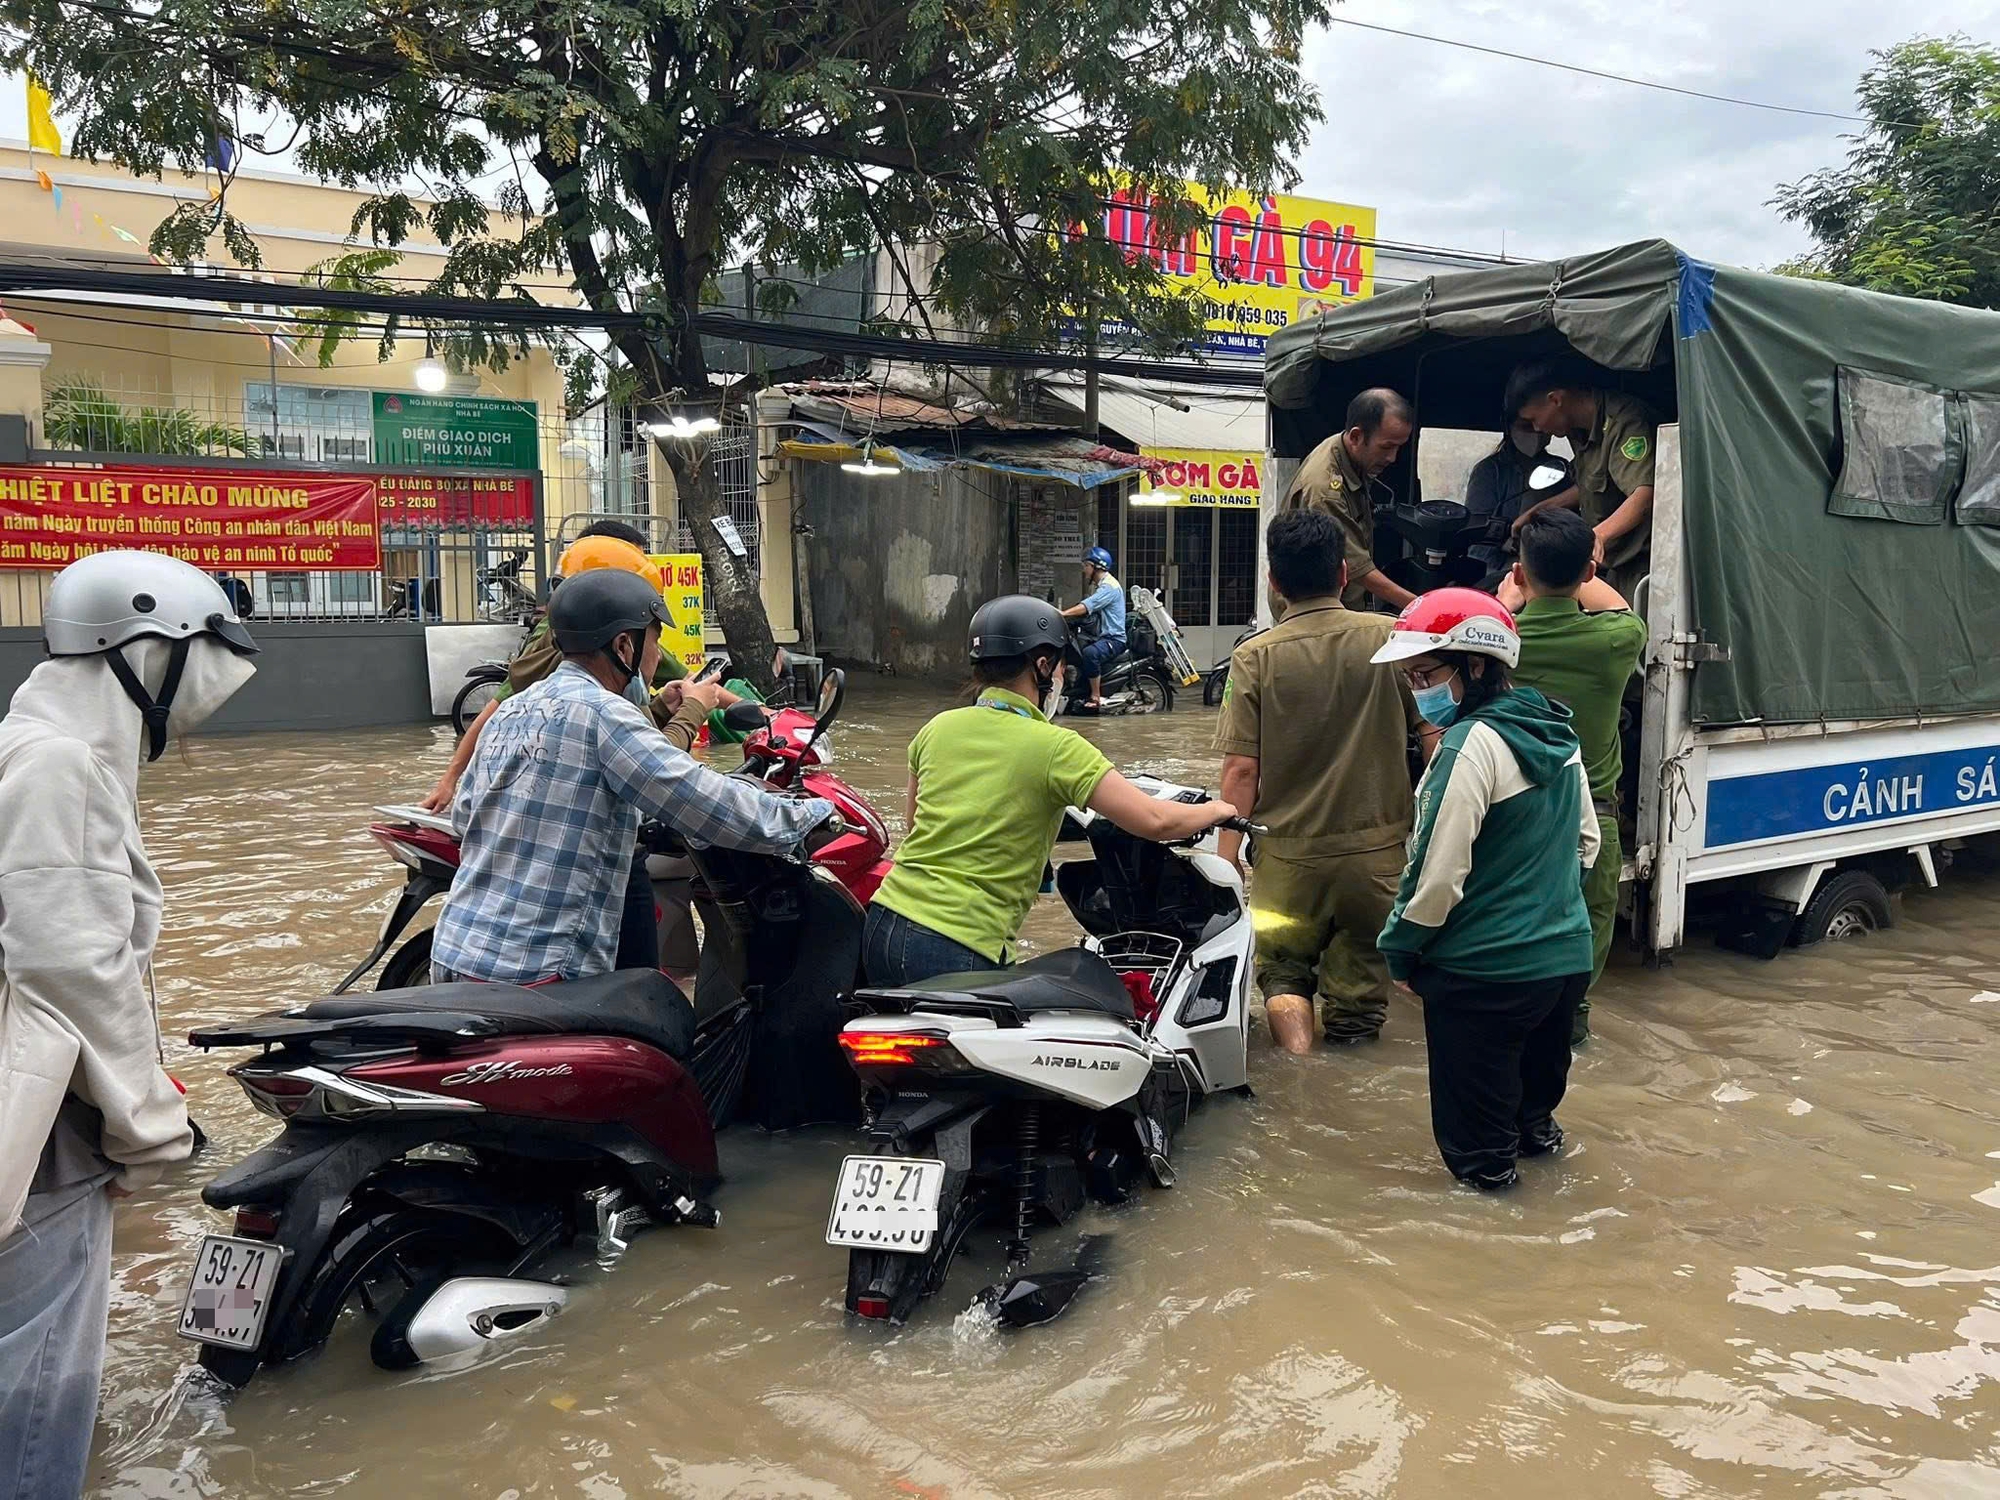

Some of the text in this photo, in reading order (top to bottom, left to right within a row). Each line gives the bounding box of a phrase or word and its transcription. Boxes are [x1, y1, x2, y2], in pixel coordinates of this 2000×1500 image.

[1212, 195, 1287, 288] GÀ
[1301, 219, 1363, 297] 94
[1265, 308, 1288, 326] 035
[1228, 335, 1246, 347] NHÀ
[438, 429, 475, 442] GIAO
[479, 431, 511, 444] DỊCH
[423, 441, 492, 457] PHÚ XUÂN
[1218, 458, 1260, 489] GÀ
[473, 478, 497, 491] NHÀ
[73, 478, 133, 508] LIỆT
[142, 481, 218, 506] CHÀO
[227, 484, 309, 508] MỪNG
[1189, 493, 1216, 504] GIAO
[407, 497, 437, 508] 2030
[3, 513, 373, 539] năm Ngày truyền thống Công an nhân dân Việt Nam
[30, 542, 70, 561] Ngày
[171, 542, 199, 561] bảo
[203, 545, 220, 565] vệ
[224, 549, 242, 561] an
[246, 546, 277, 562] ninh
[280, 542, 297, 562] Tổ
[678, 566, 699, 587] 45K
[683, 596, 700, 608] 37K
[684, 624, 701, 636] 45K
[1465, 626, 1505, 643] Cvara
[685, 653, 702, 665] 32K
[1823, 756, 1998, 822] CẢNH SÁ
[1030, 1055, 1121, 1071] AIRBLADE
[509, 1063, 573, 1080] mode
